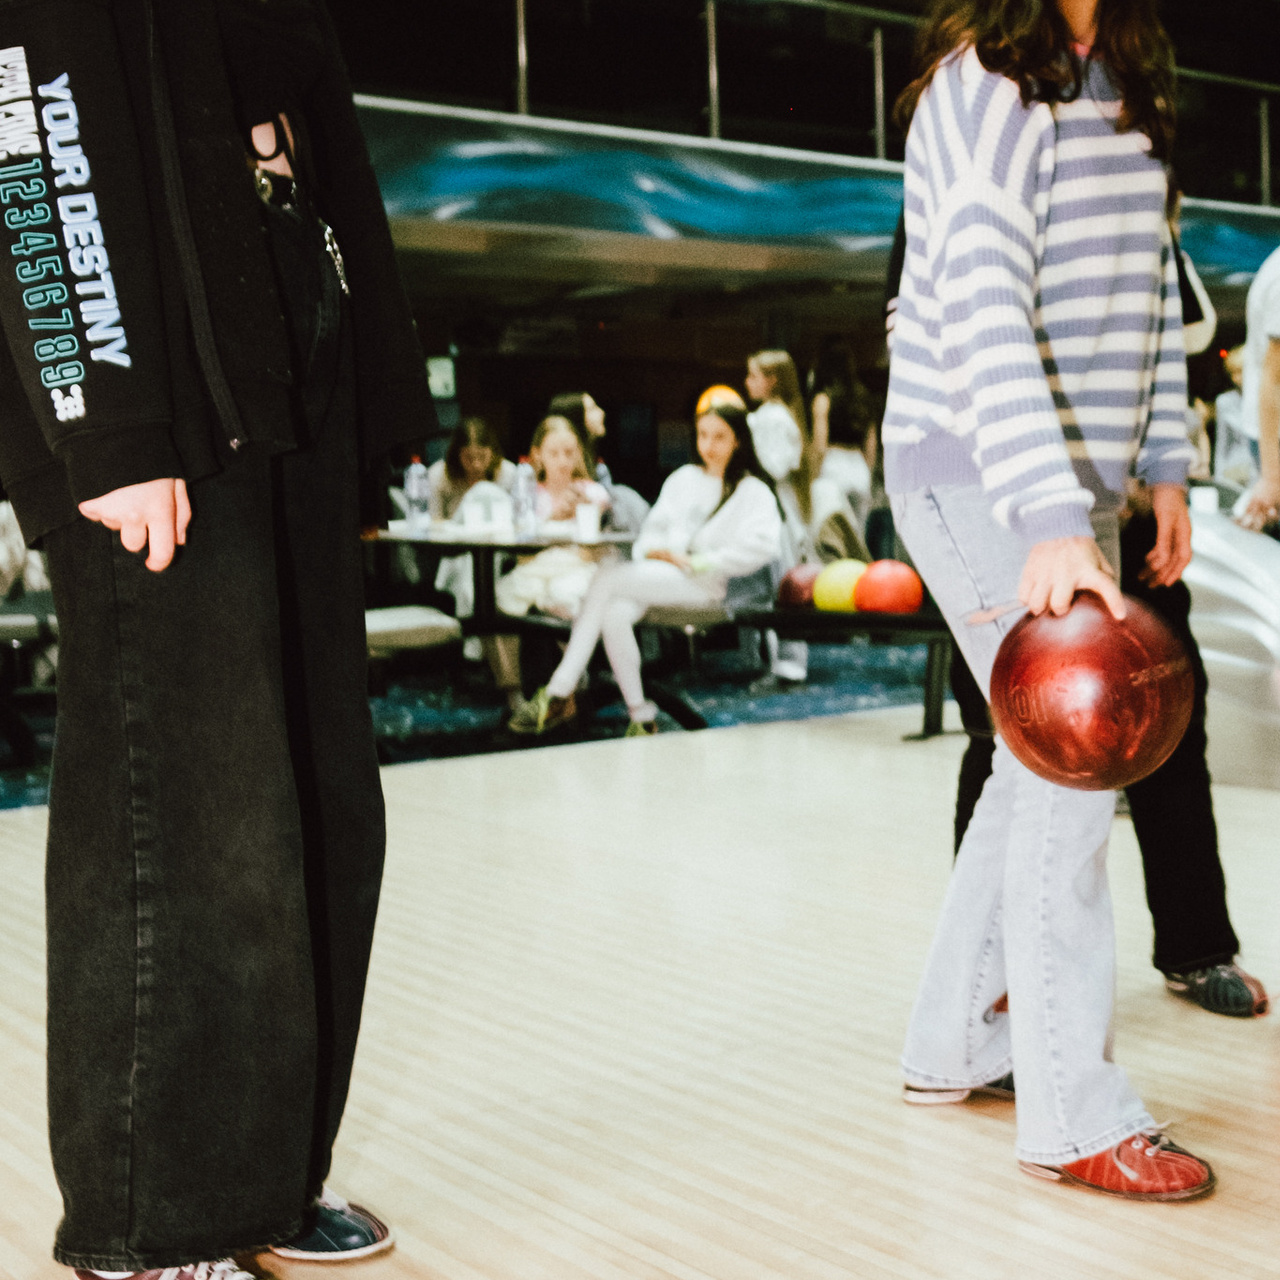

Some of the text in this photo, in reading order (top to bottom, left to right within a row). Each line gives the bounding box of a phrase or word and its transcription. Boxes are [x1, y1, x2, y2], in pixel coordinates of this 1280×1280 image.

[0, 157, 86, 389] 123456789
[37, 72, 132, 368] YOUR DESTINY
